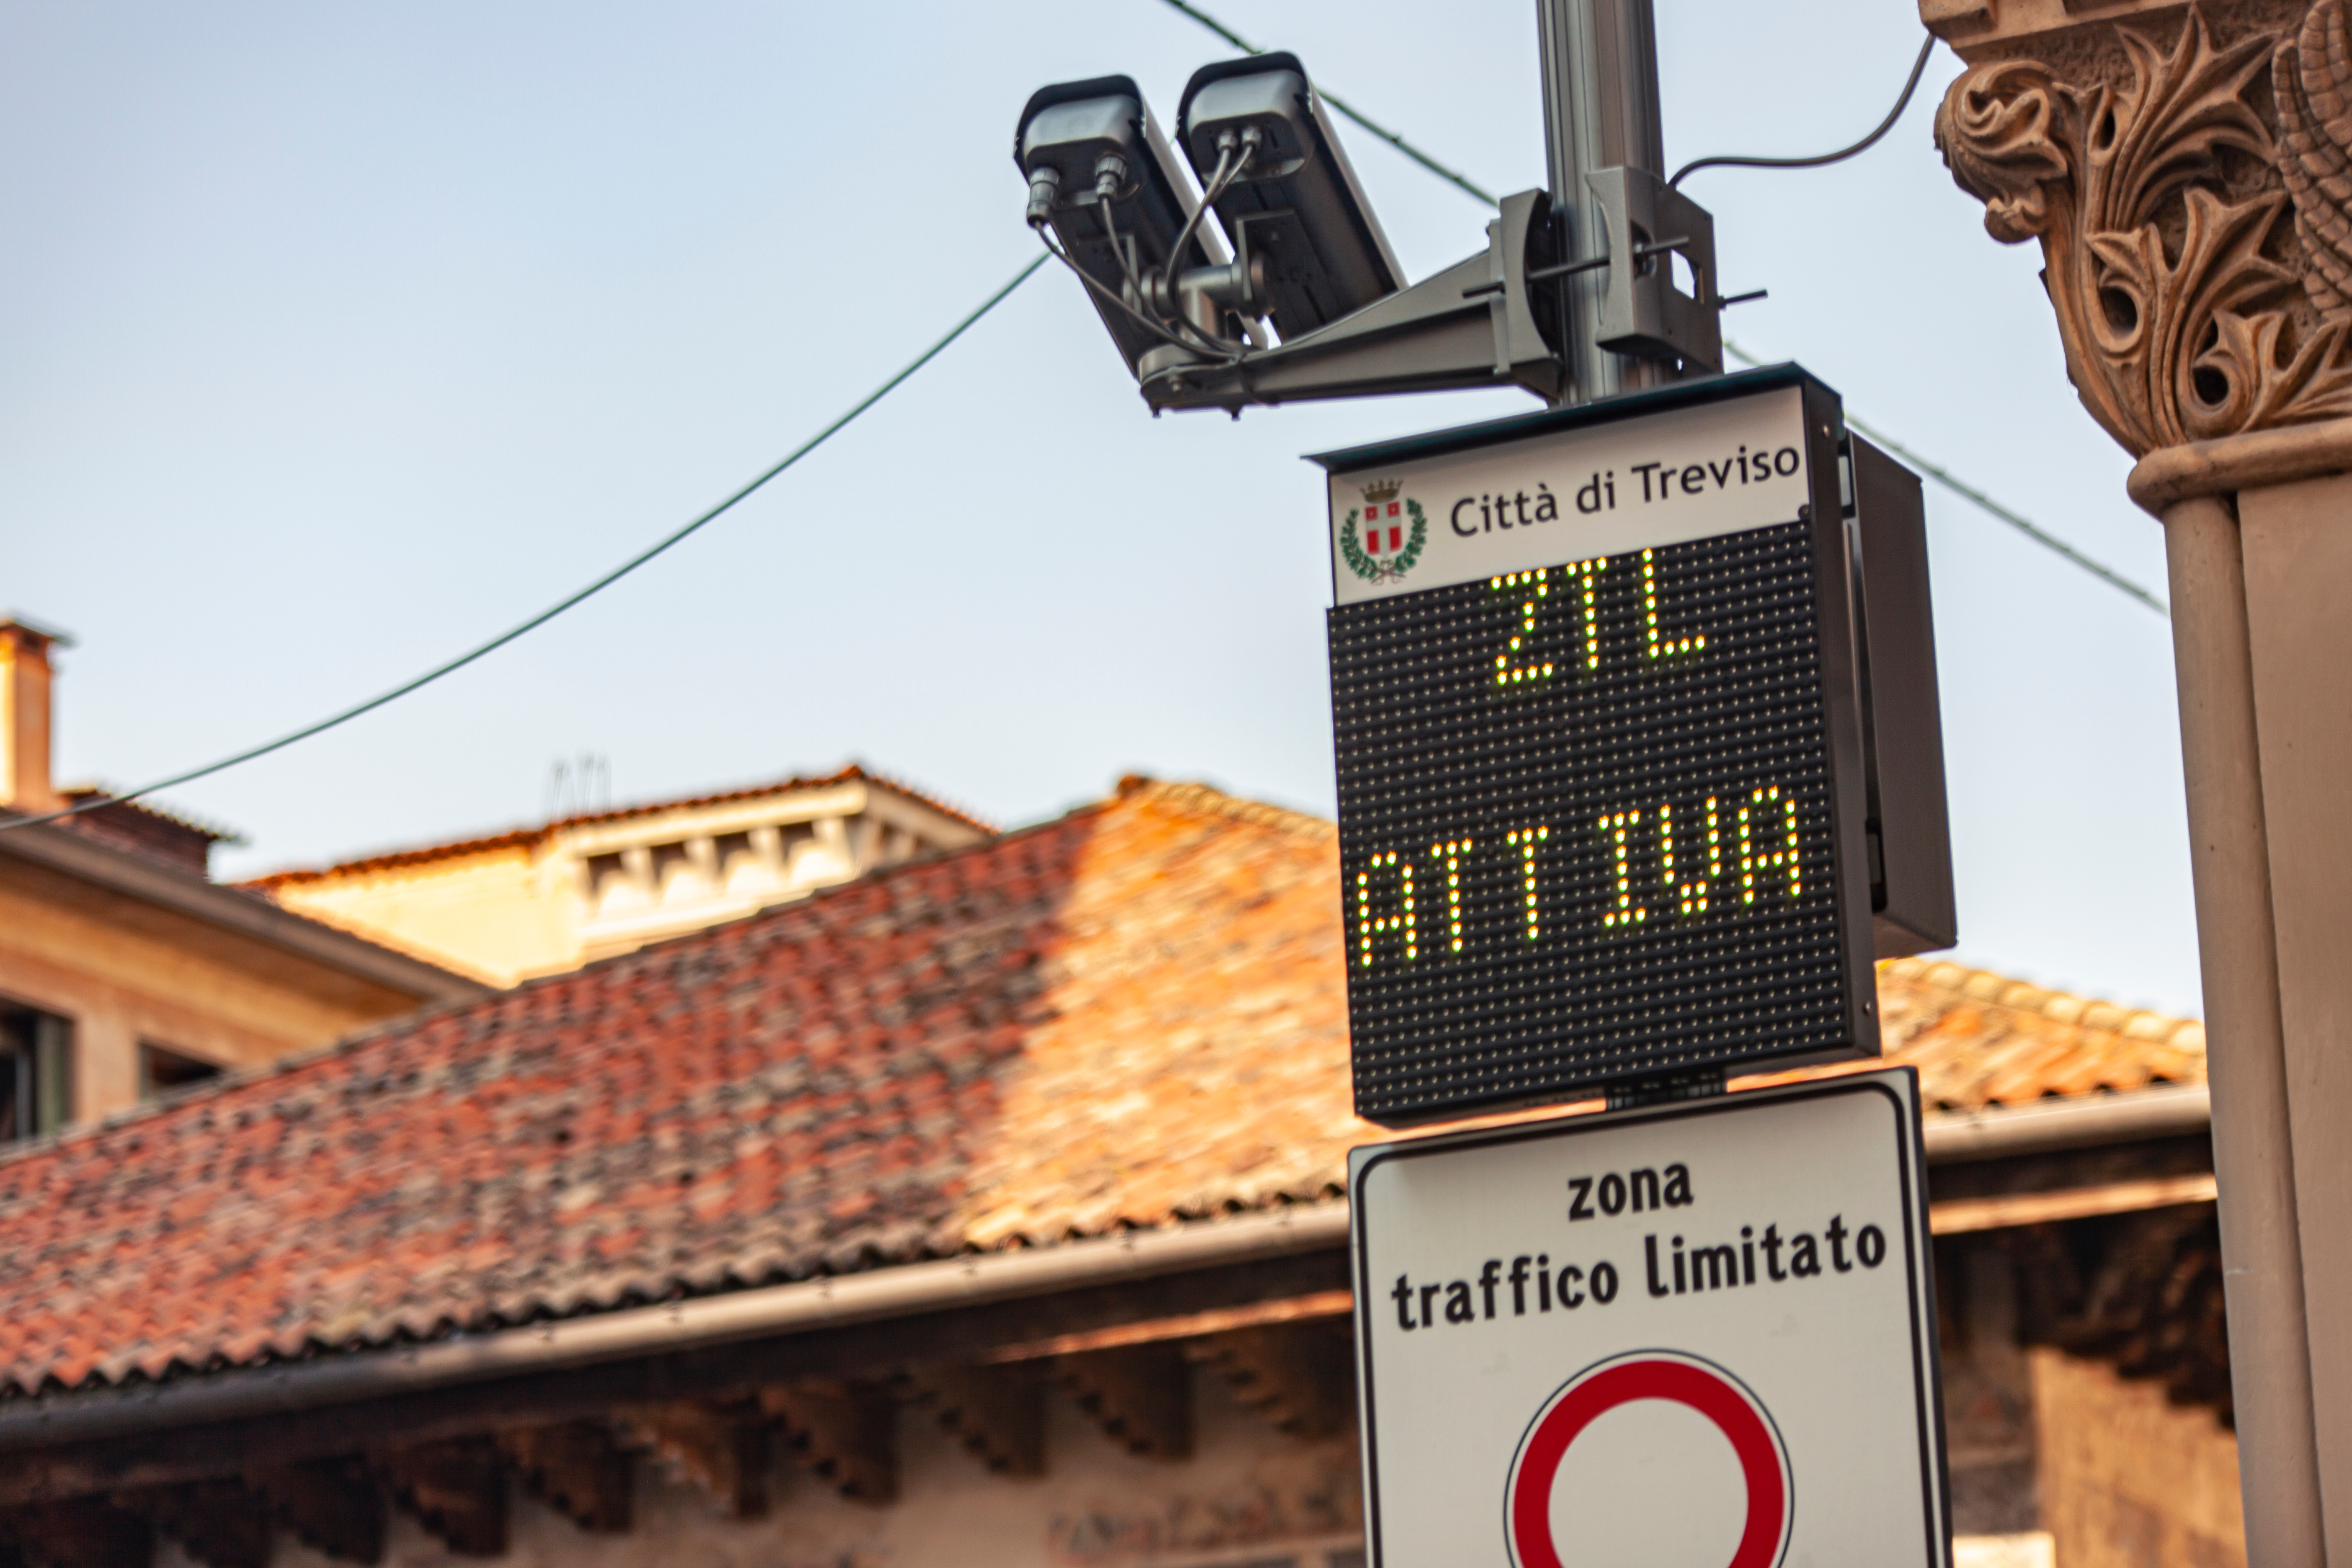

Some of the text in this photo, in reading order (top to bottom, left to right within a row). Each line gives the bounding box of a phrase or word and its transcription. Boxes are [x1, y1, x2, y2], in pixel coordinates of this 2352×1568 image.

[1451, 445, 1800, 538] Città di Treviso
[1491, 548, 1706, 686] ZTL
[1356, 785, 1802, 967] ATTIVA
[1568, 1163, 1694, 1222] zona
[1391, 1214, 1886, 1332] traffico limitato
